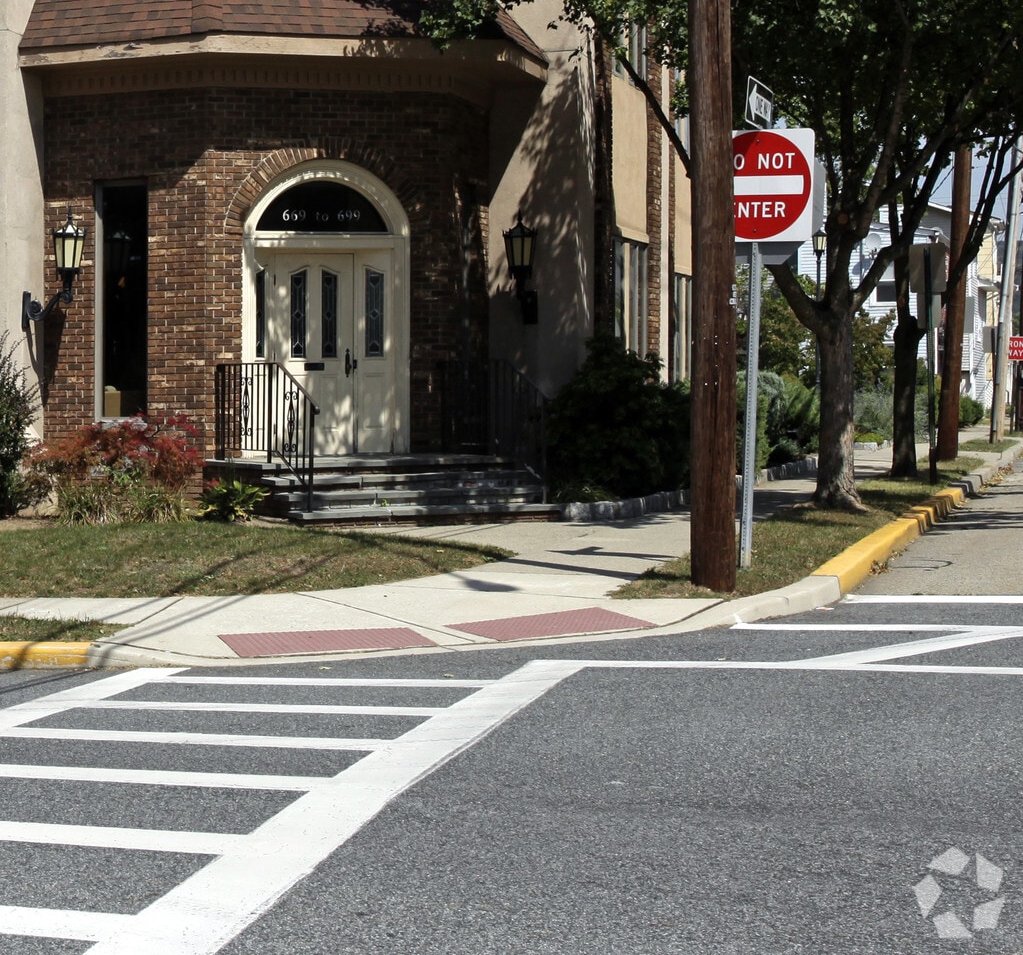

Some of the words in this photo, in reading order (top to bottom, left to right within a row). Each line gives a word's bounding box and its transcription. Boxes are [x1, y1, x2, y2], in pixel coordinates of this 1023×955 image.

[733, 153, 745, 171] O
[757, 152, 796, 170] NOT
[282, 208, 306, 222] 669
[316, 210, 329, 221] to
[337, 209, 361, 222] 699
[733, 201, 786, 219] NTER
